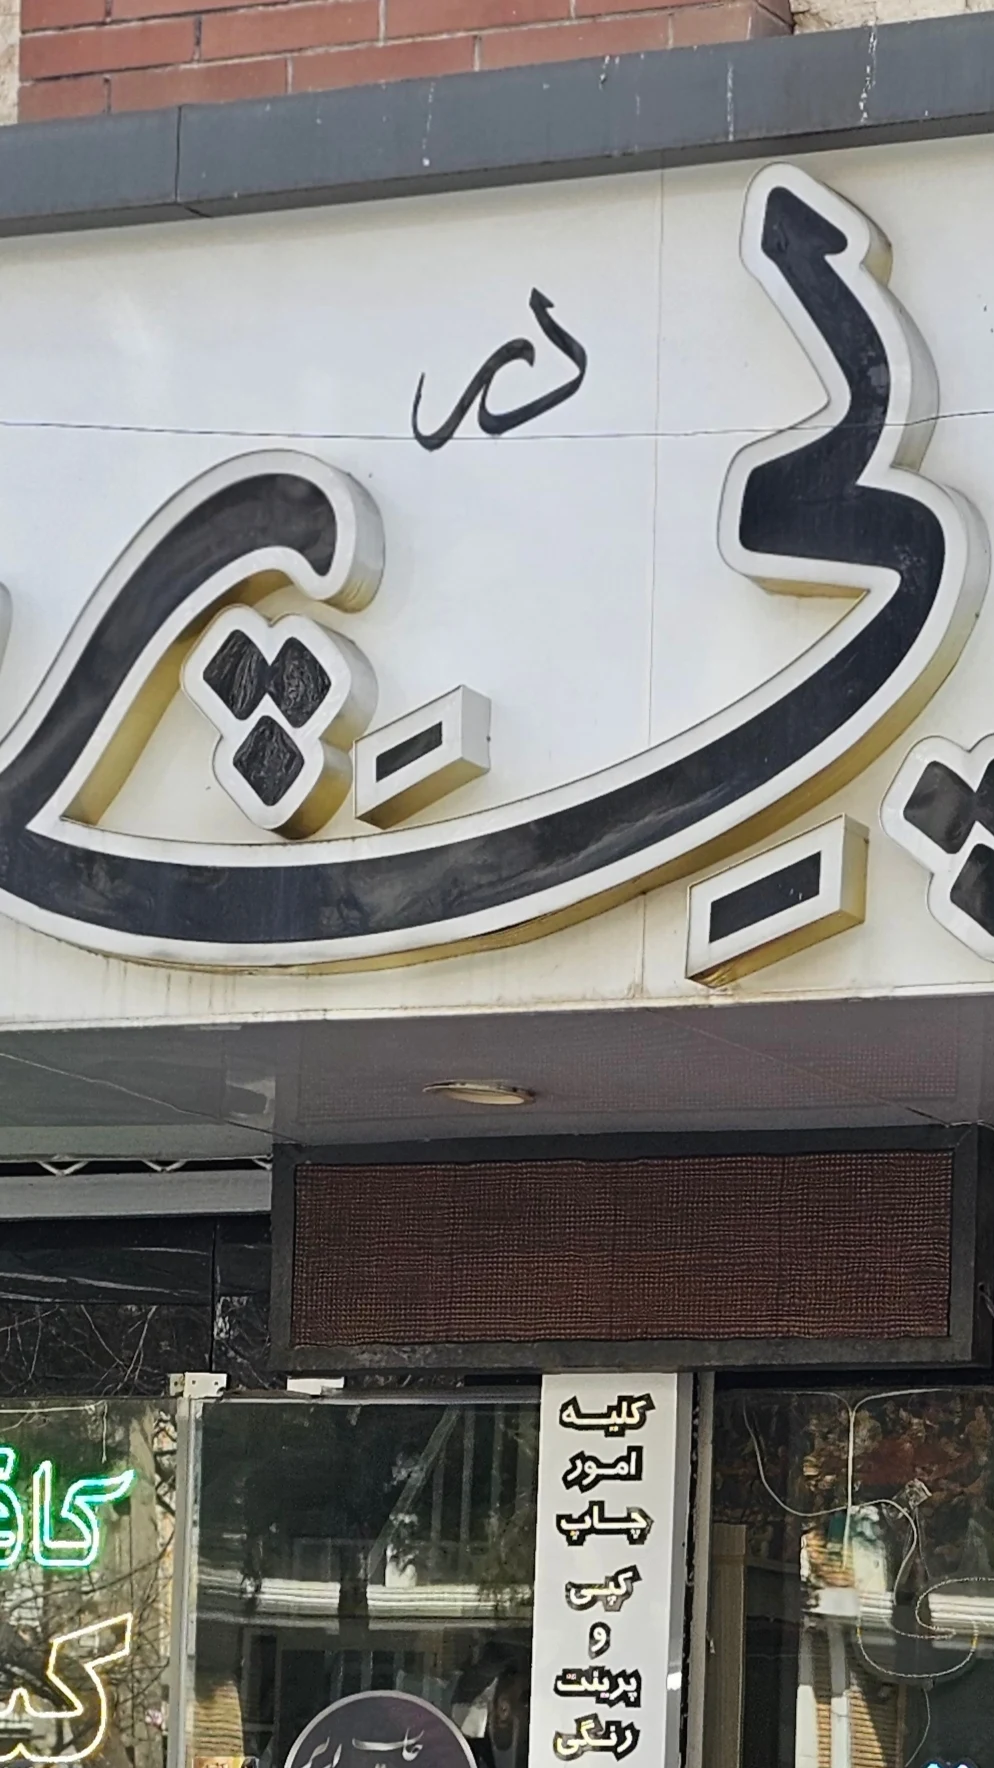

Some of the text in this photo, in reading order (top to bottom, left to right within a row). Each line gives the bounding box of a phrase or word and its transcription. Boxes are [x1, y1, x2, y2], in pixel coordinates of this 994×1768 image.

[559, 1394, 655, 1437] کلیه
[562, 1446, 643, 1493] امور
[556, 1501, 653, 1546] چاپ
[565, 1565, 642, 1612] کپی
[588, 1622, 610, 1658] و
[554, 1665, 641, 1707] پرینت
[553, 1713, 640, 1760] رنگی
